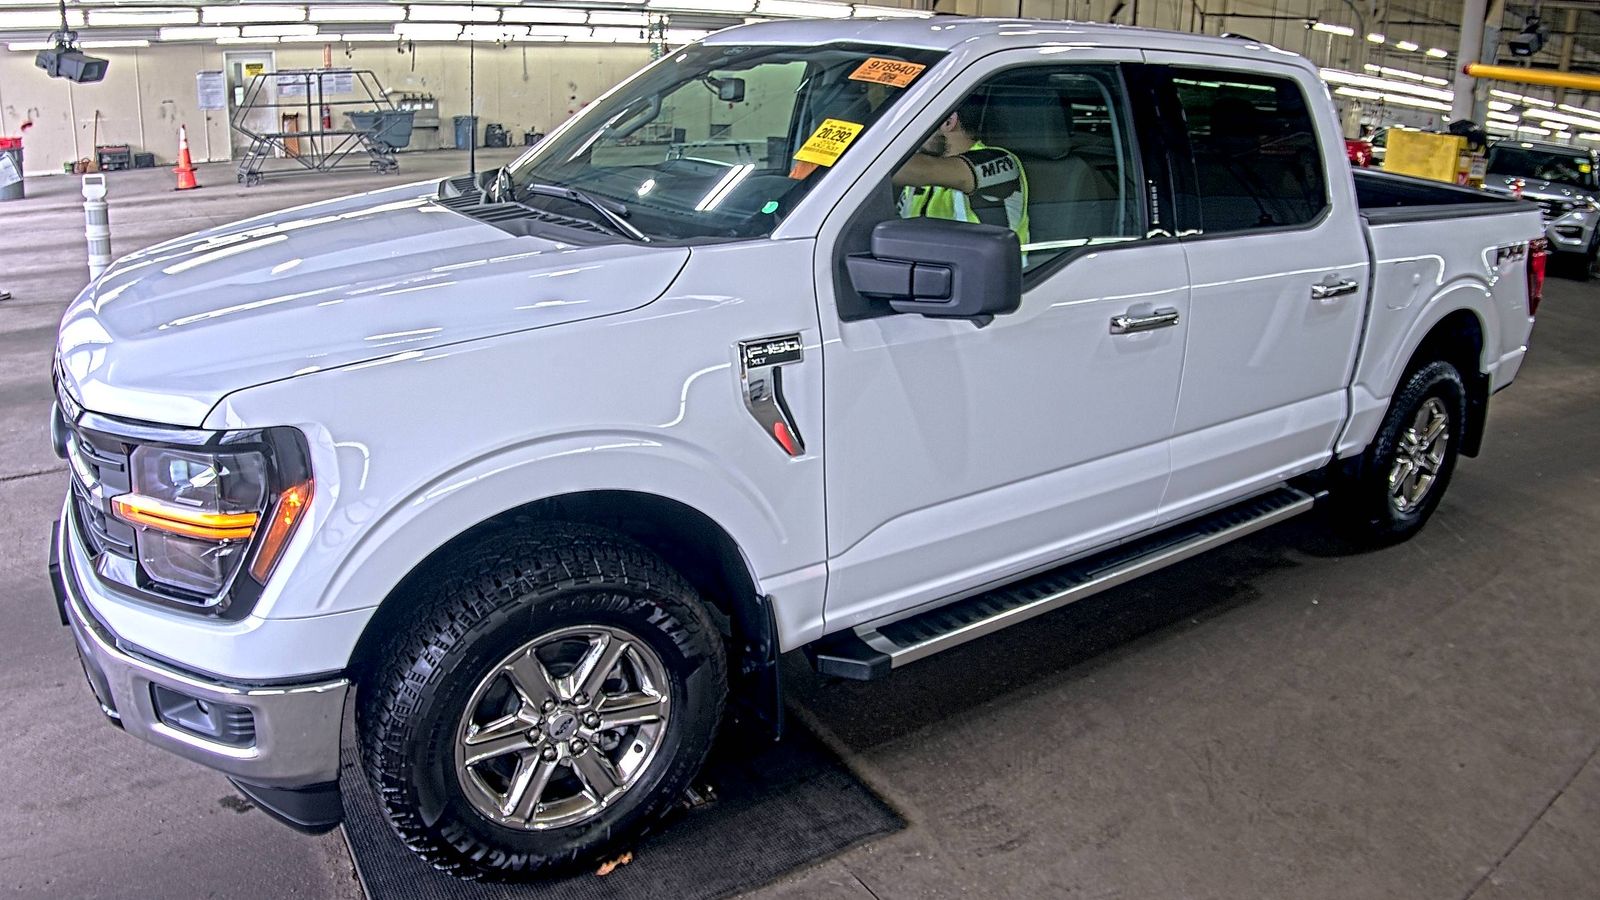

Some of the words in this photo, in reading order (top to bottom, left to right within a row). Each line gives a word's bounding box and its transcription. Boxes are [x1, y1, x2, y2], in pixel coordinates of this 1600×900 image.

[747, 340, 800, 358] F-150
[750, 356, 767, 366] XLT
[440, 819, 556, 872] ANGLER
